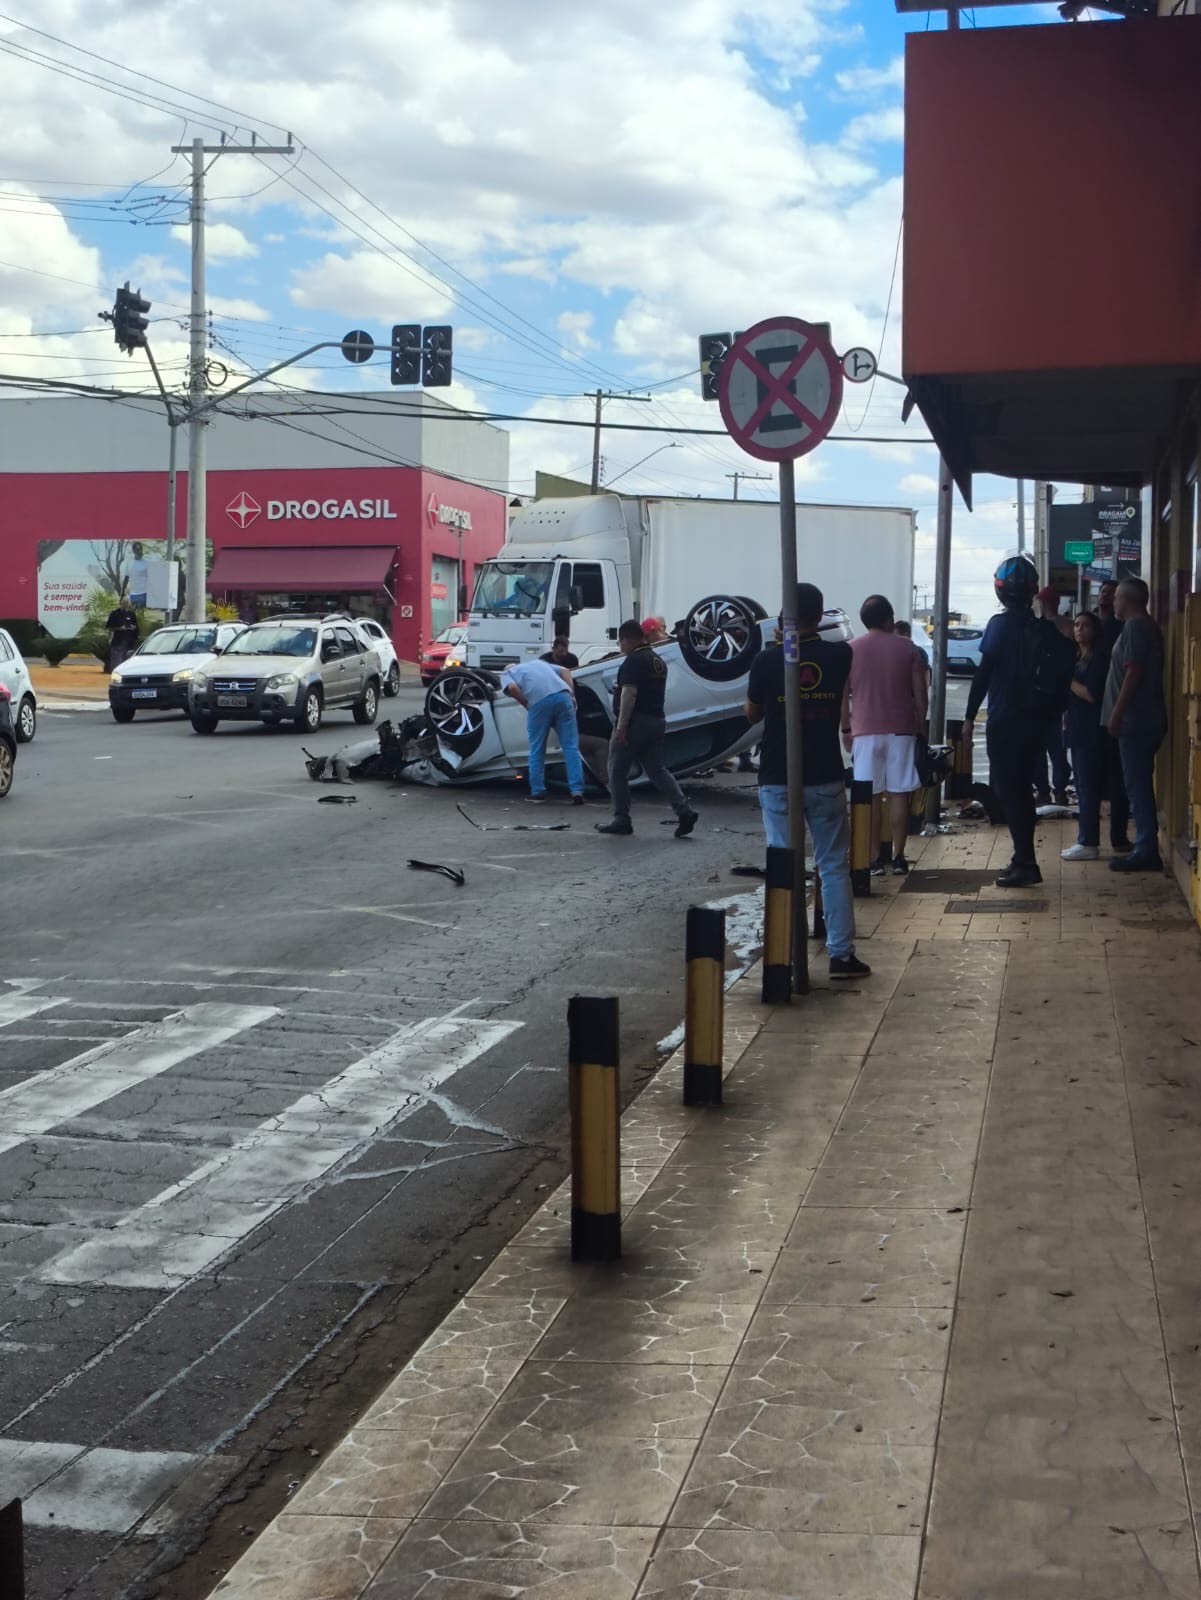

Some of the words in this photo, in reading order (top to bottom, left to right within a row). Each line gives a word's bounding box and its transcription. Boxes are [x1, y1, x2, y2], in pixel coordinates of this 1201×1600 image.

[267, 499, 398, 520] DROGASIL
[43, 582, 60, 590] Sua
[50, 594, 82, 602] sempre
